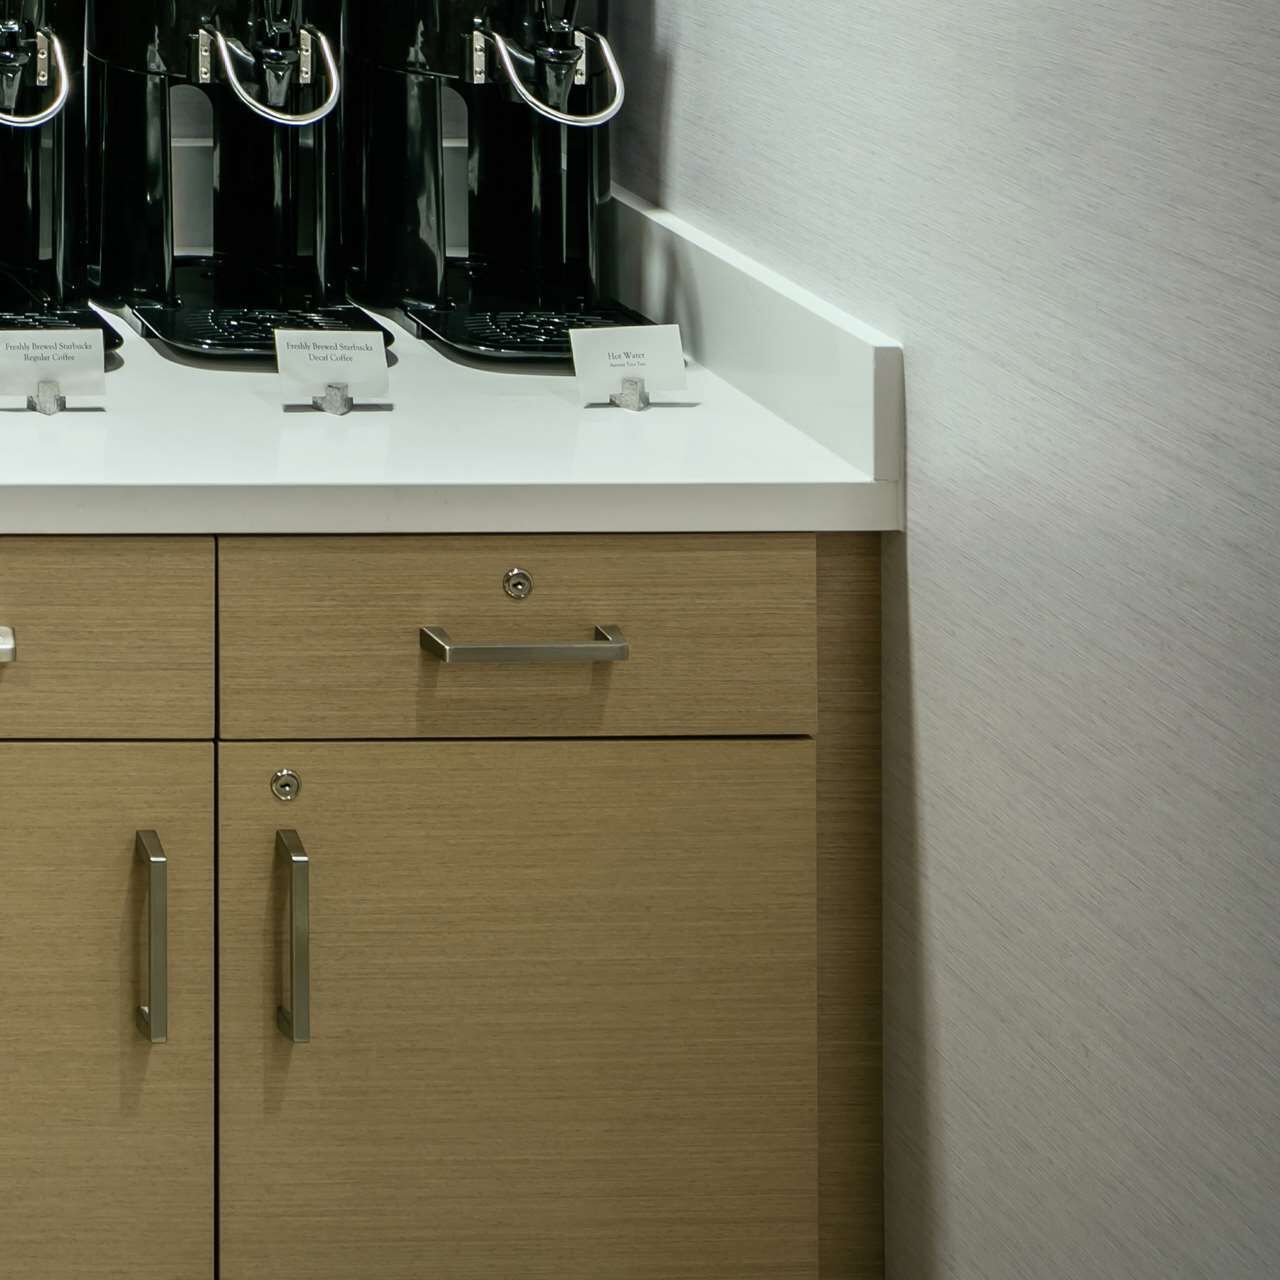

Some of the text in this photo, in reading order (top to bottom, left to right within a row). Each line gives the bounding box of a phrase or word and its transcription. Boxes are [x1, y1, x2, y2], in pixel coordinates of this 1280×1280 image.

[5, 341, 92, 352] Freshly Brewed Starbucks
[286, 342, 373, 351] Freshly Brewed Starbucks
[24, 353, 75, 363] Regular Coffee
[330, 353, 353, 361] Coffee
[608, 351, 645, 360] Hot Water
